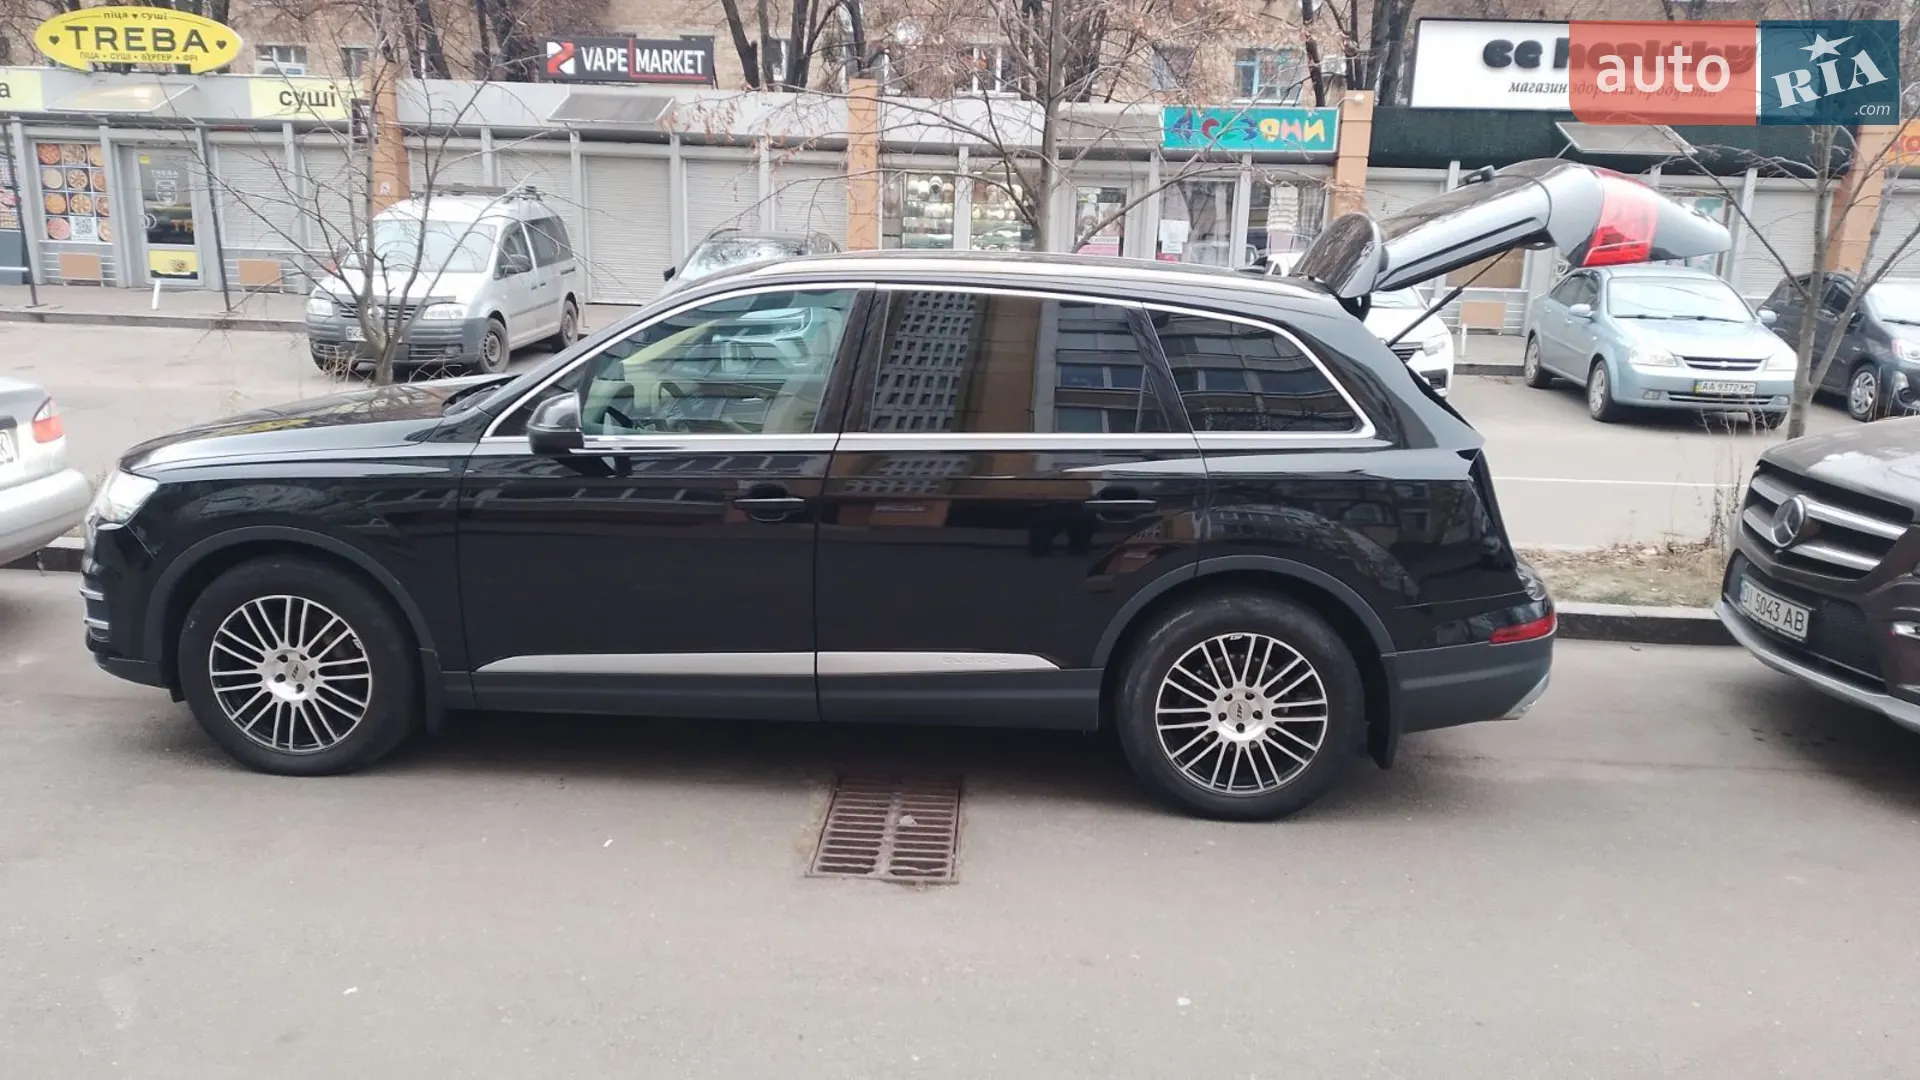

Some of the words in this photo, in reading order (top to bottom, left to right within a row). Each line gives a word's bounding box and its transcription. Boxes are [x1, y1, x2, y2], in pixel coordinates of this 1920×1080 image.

[103, 11, 128, 20] піца
[140, 12, 168, 21] суші
[64, 25, 210, 53] TREBA
[581, 46, 628, 72] VAPE
[635, 48, 705, 74] MARKET
[279, 85, 336, 112] суші
[1508, 82, 1567, 94] магазин
[1755, 593, 1781, 622] 5043
[1783, 607, 1805, 633] AB
